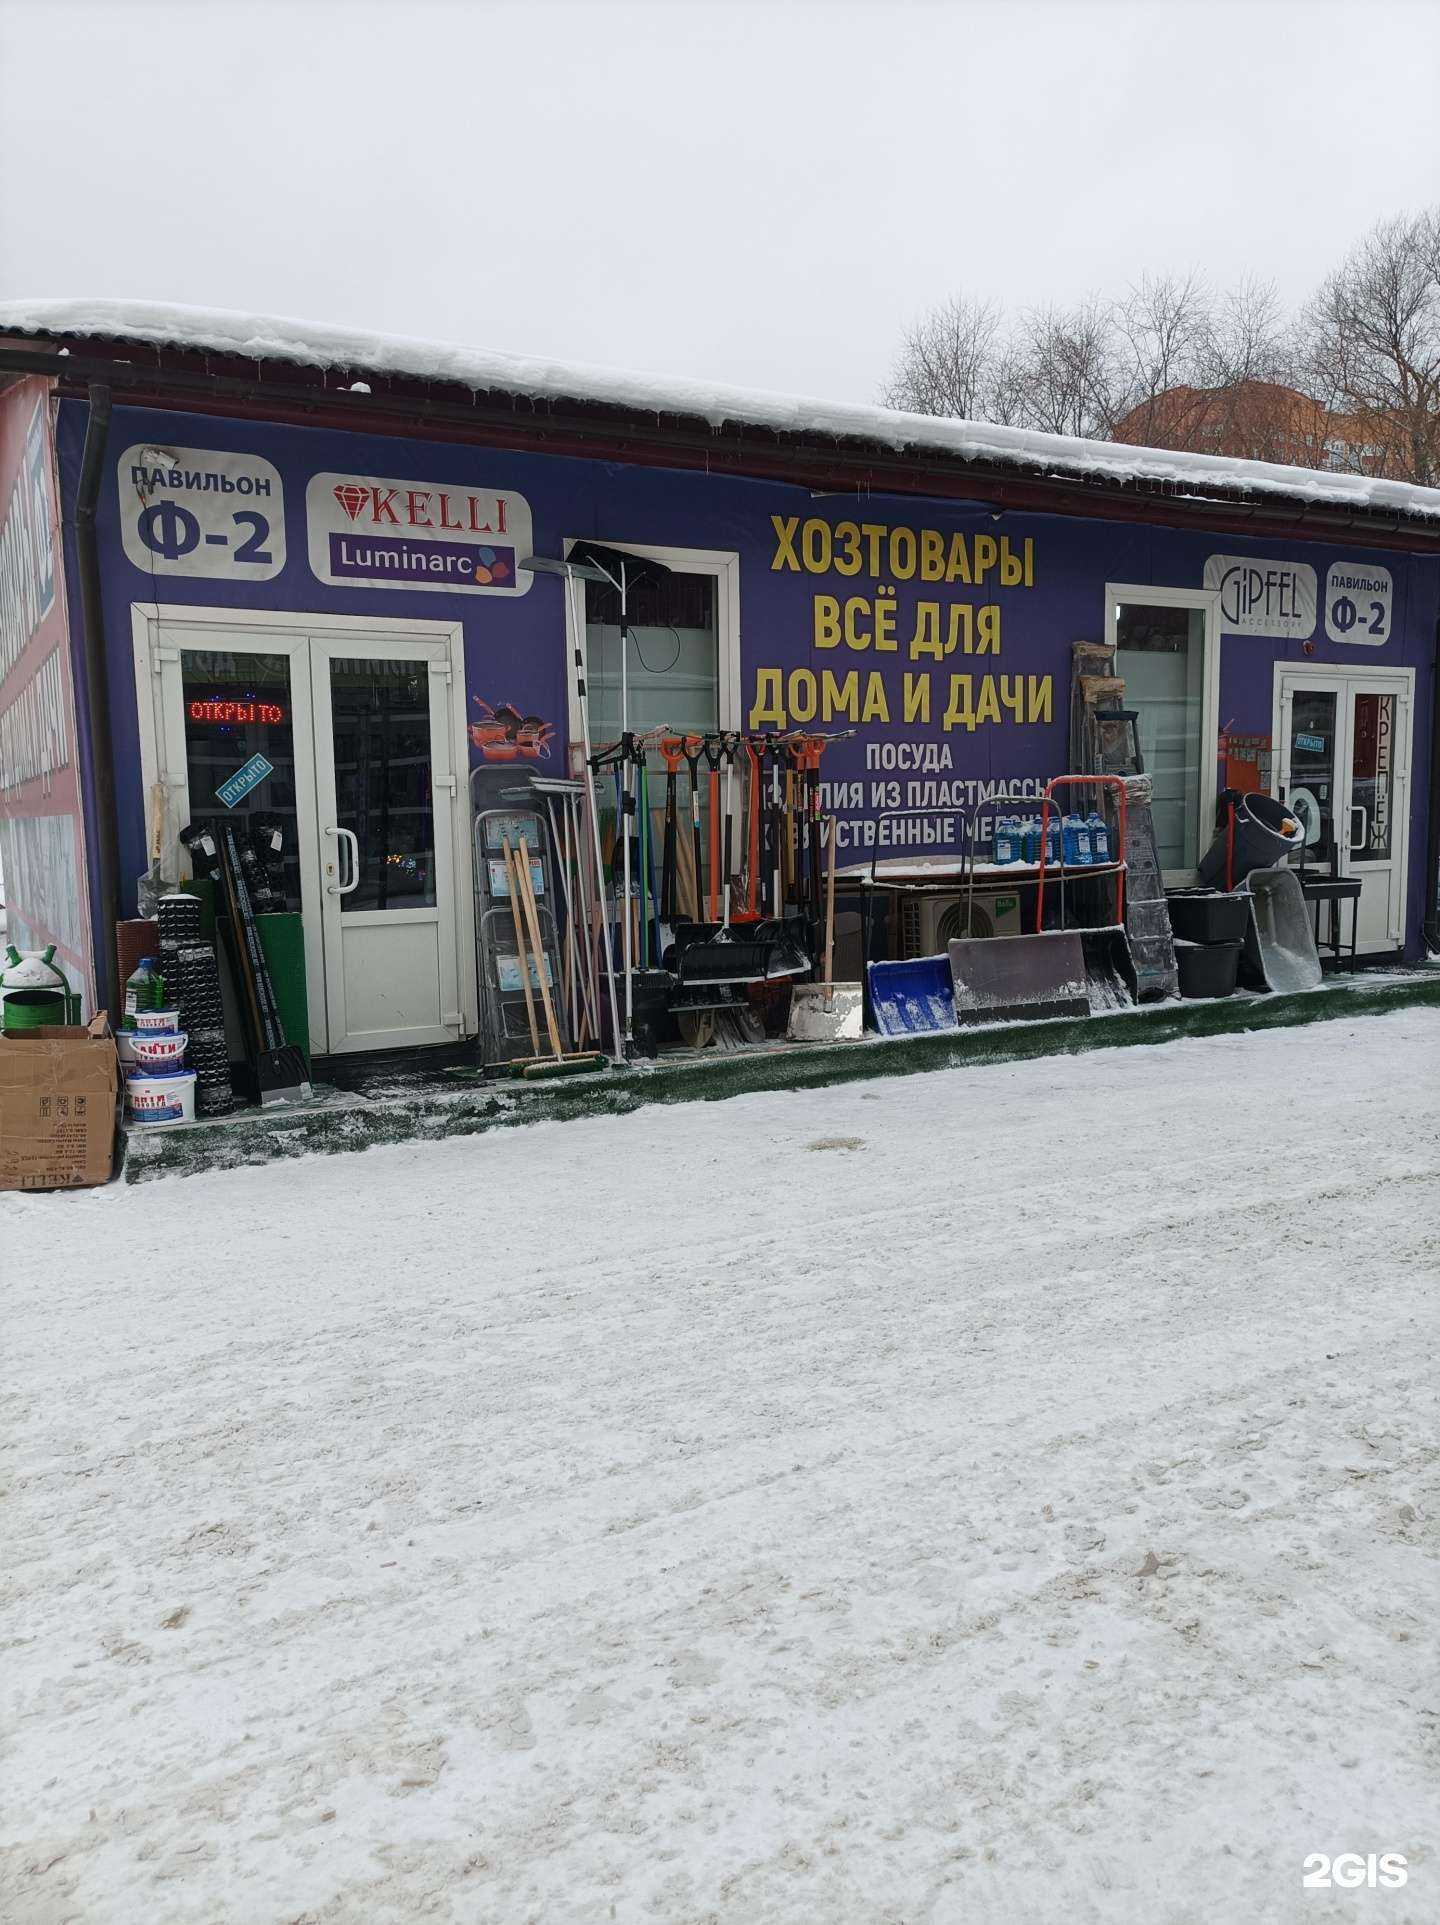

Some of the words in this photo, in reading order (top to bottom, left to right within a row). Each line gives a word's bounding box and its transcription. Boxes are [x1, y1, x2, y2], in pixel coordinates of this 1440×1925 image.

[130, 465, 271, 496] ПАВИЛЬОН
[370, 486, 508, 534] KELLI
[137, 500, 272, 564] Ф-2
[770, 515, 1034, 587] ХОЗТОВАРЫ
[341, 540, 472, 574] Luminarc
[1331, 575, 1388, 593] ПАВИЛЬОН
[814, 585, 898, 651] ВСЁ
[909, 602, 1000, 661] ДЛЯ
[1331, 596, 1385, 635] Ф-2
[191, 702, 282, 722] ОТКРЫТО
[750, 668, 890, 730] ДОМА
[903, 672, 930, 723] И
[943, 674, 1052, 731] ДАЧИ
[866, 743, 953, 773] ПОСУДА
[222, 760, 266, 801] ОТКРЫТО
[871, 781, 901, 807] ИЗ
